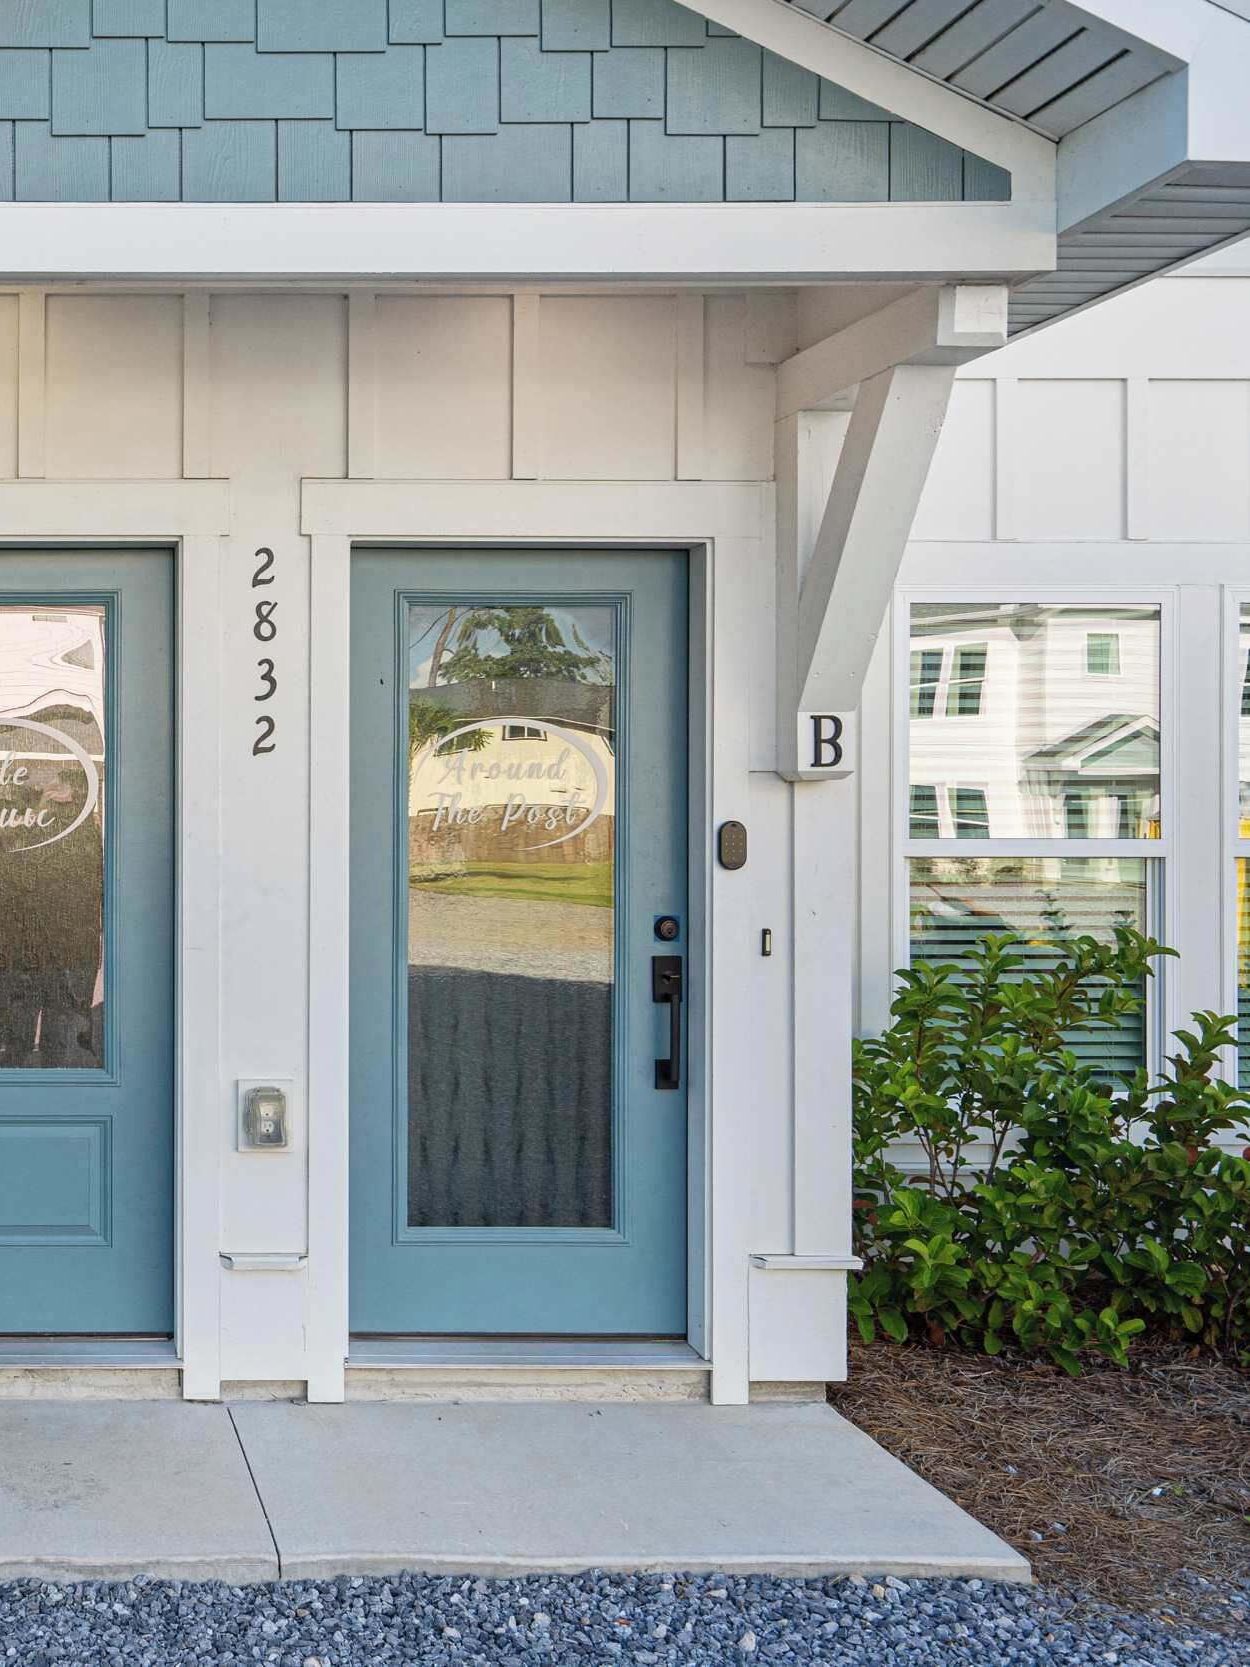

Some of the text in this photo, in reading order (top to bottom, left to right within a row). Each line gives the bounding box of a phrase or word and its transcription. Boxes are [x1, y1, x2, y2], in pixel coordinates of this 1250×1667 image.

[251, 547, 278, 757] 2832
[810, 714, 843, 768] B
[437, 747, 571, 785] Around
[427, 791, 587, 832] The Post
